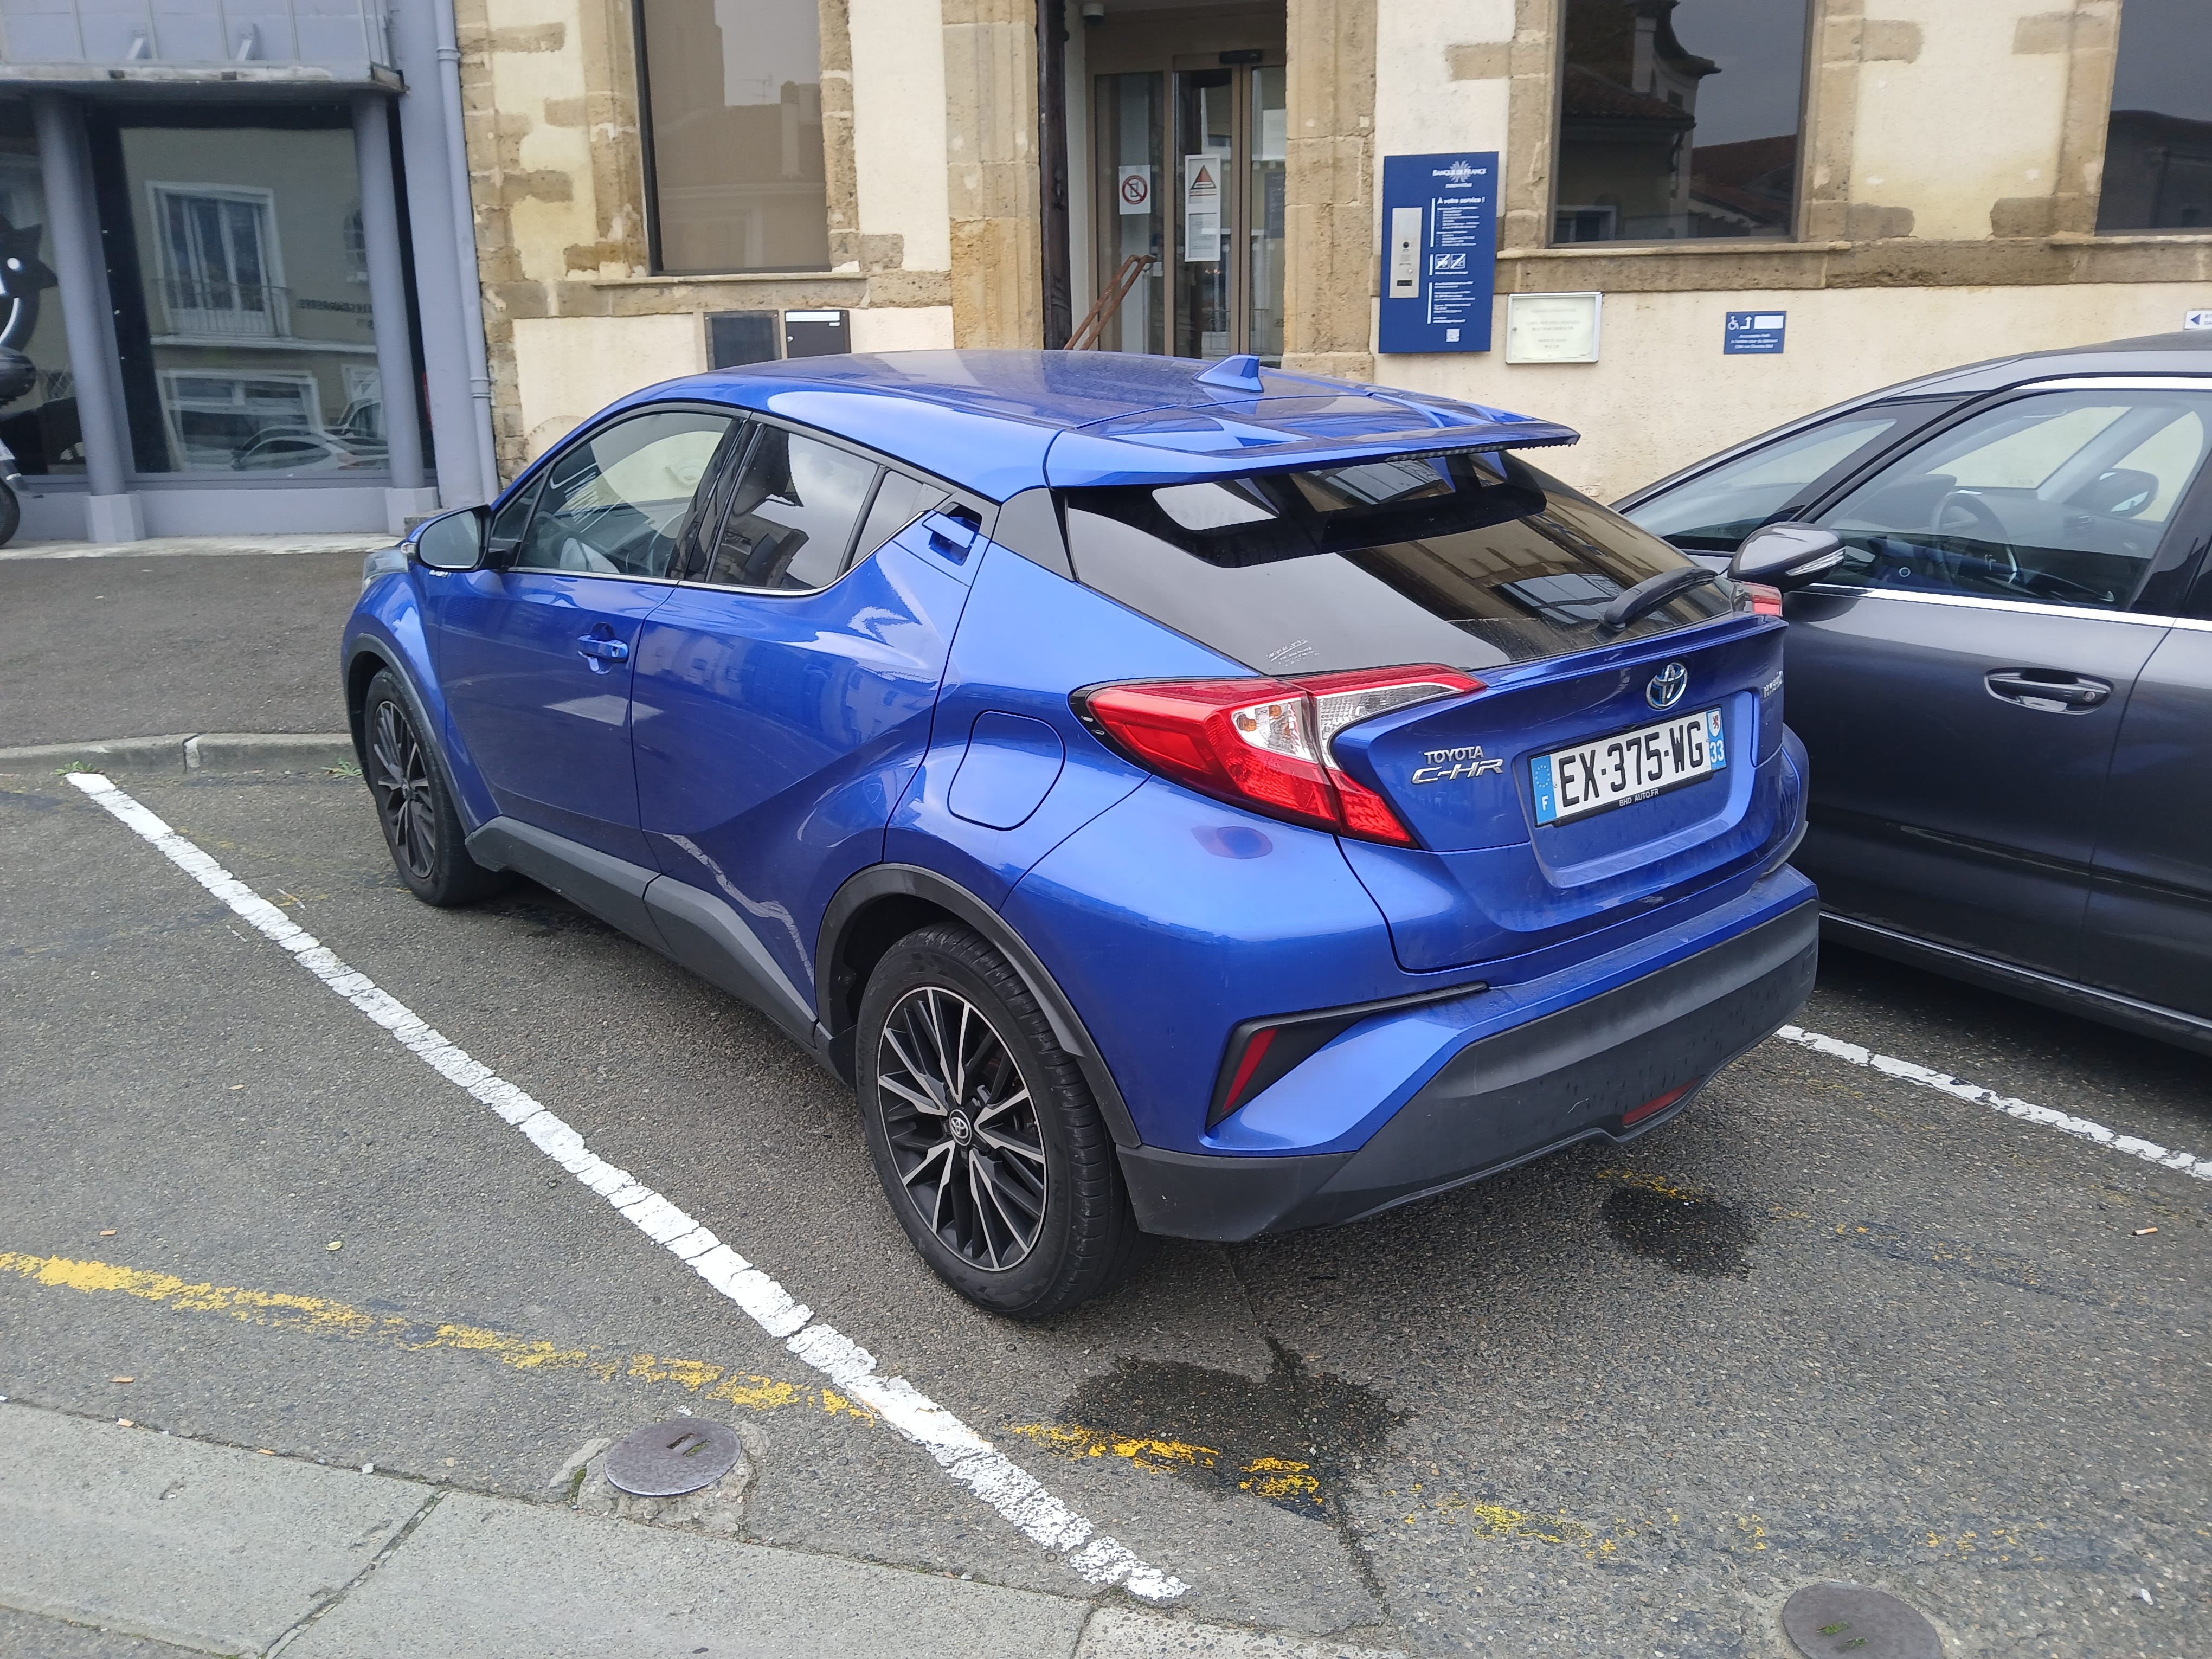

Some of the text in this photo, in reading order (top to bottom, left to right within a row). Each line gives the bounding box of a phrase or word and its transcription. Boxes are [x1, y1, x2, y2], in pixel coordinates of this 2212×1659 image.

[1424, 745, 1484, 765] TOYOTA
[1709, 739, 1725, 764] 33
[1412, 758, 1503, 785] C-HR
[1541, 795, 1549, 811] F
[1619, 788, 1660, 807] BHD AUTO.FR
